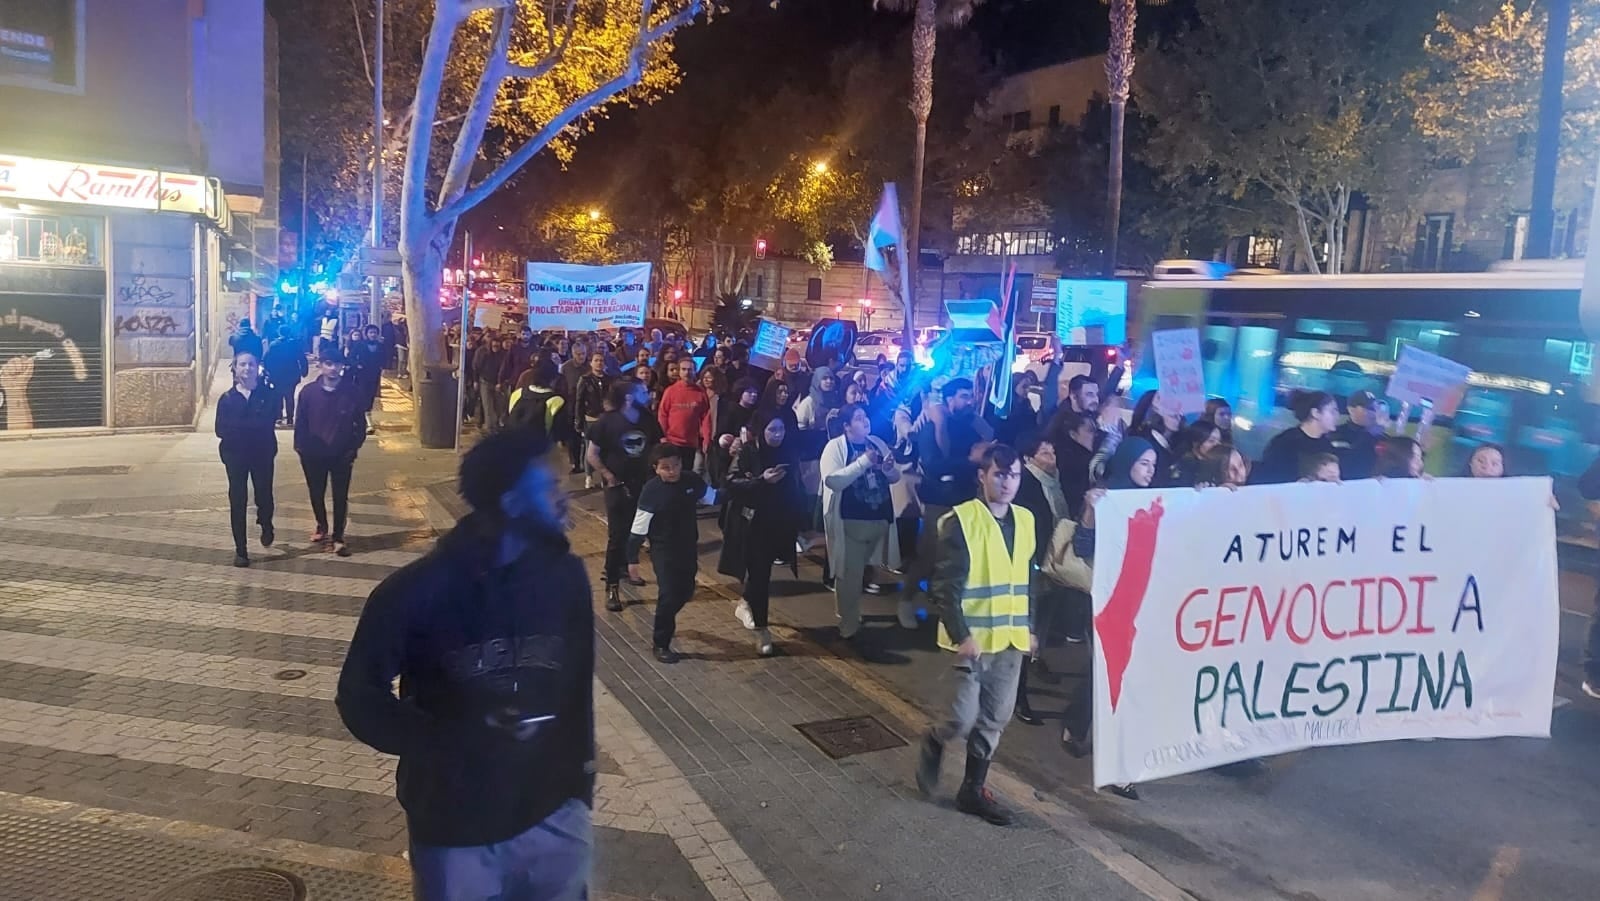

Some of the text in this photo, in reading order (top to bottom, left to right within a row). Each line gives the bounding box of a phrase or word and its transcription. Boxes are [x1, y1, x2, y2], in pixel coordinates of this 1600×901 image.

[529, 283, 560, 293] CONTRA
[563, 284, 573, 293] LA
[529, 303, 640, 314] PROLETARIAT INTERNACIONAL
[1223, 525, 1433, 563] ATUREM EL
[1175, 573, 1484, 652] GENOCIDI A
[1193, 650, 1473, 735] PALESTINA
